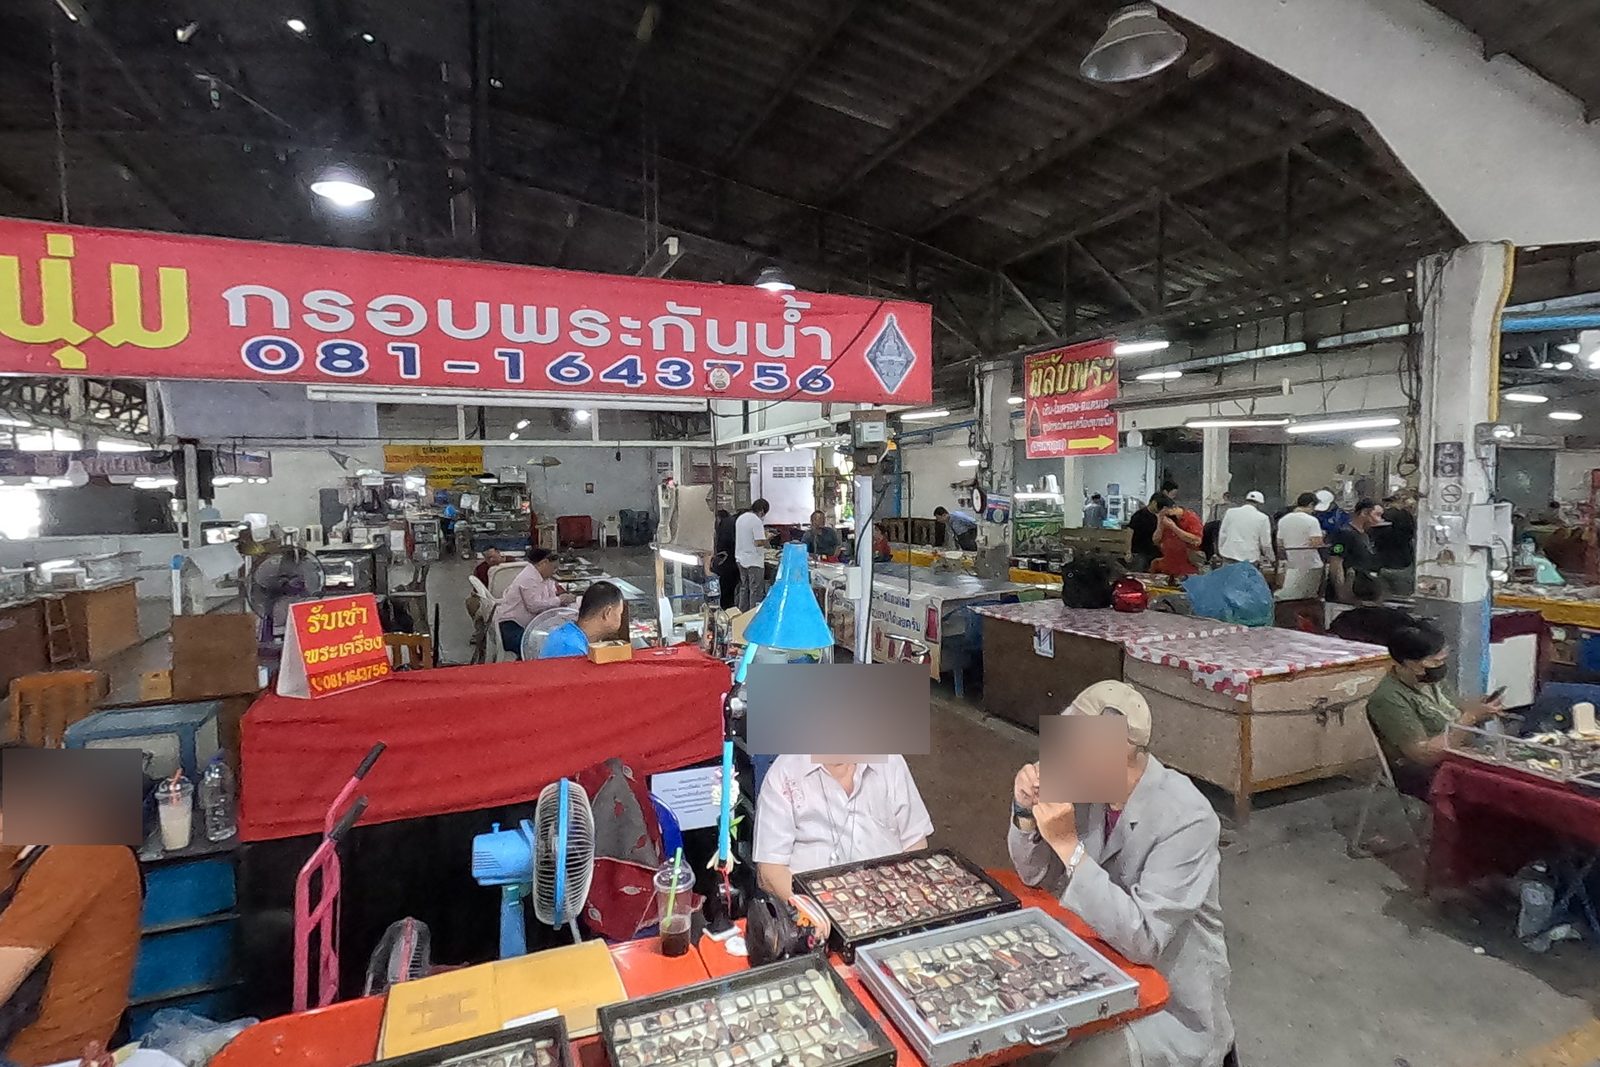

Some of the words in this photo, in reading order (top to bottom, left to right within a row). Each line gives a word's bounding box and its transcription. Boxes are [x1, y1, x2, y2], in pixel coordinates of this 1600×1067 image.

[221, 285, 832, 361] กรอบพระกันน้ำ
[306, 601, 368, 634] รับเช่า
[304, 630, 383, 665] พระเครื่อง
